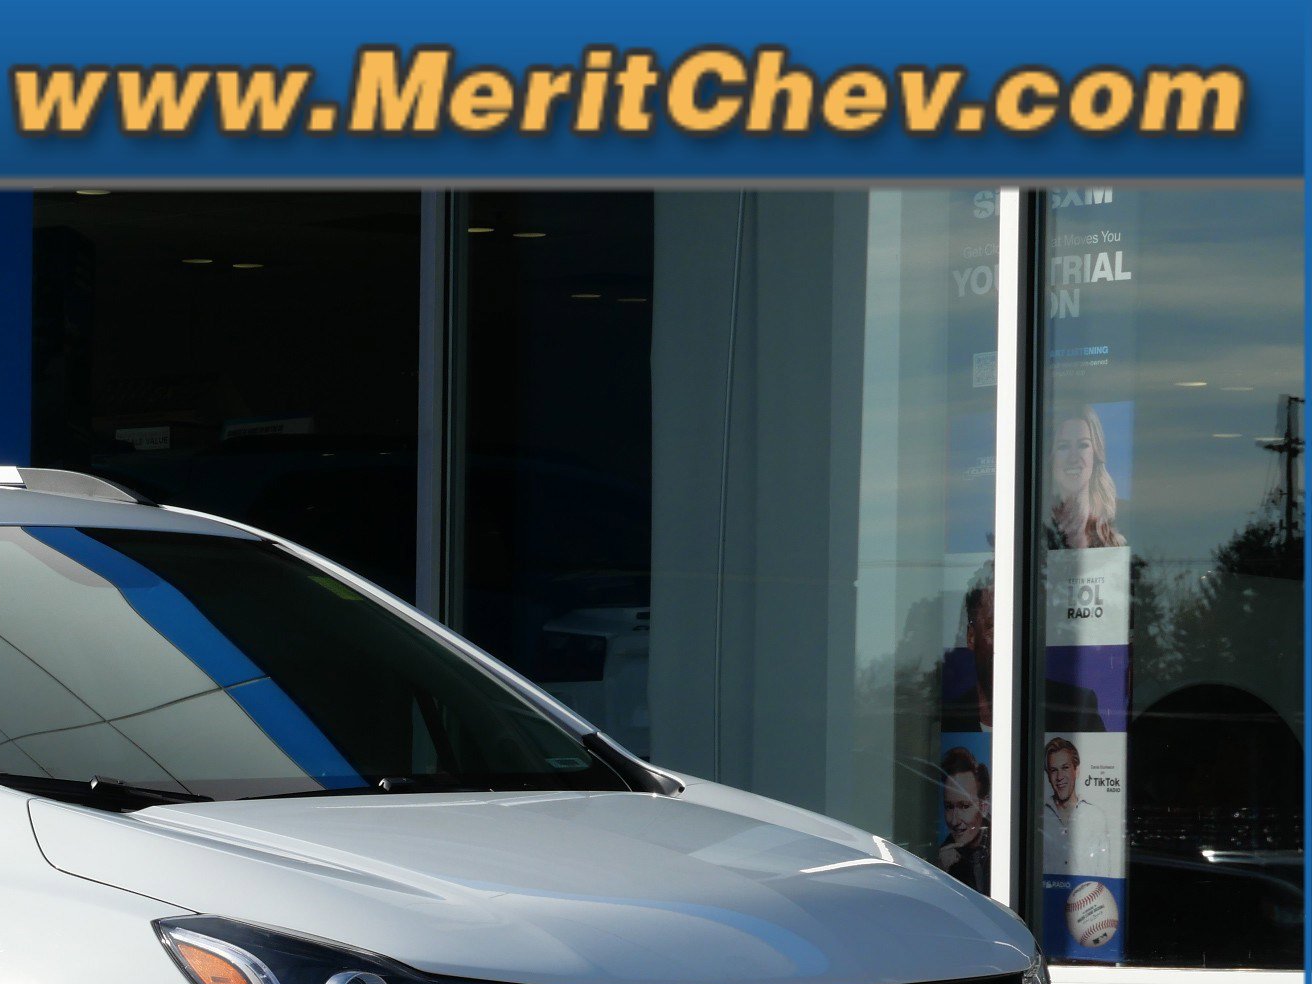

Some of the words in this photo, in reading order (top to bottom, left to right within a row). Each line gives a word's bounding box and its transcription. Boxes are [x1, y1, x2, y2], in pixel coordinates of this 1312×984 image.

[1064, 233, 1099, 247] Moves
[1100, 230, 1122, 244] You
[1050, 251, 1132, 287] TRIAL
[1068, 585, 1103, 606] LOL
[1067, 607, 1103, 619] RADIO
[1093, 777, 1121, 787] TikTok
